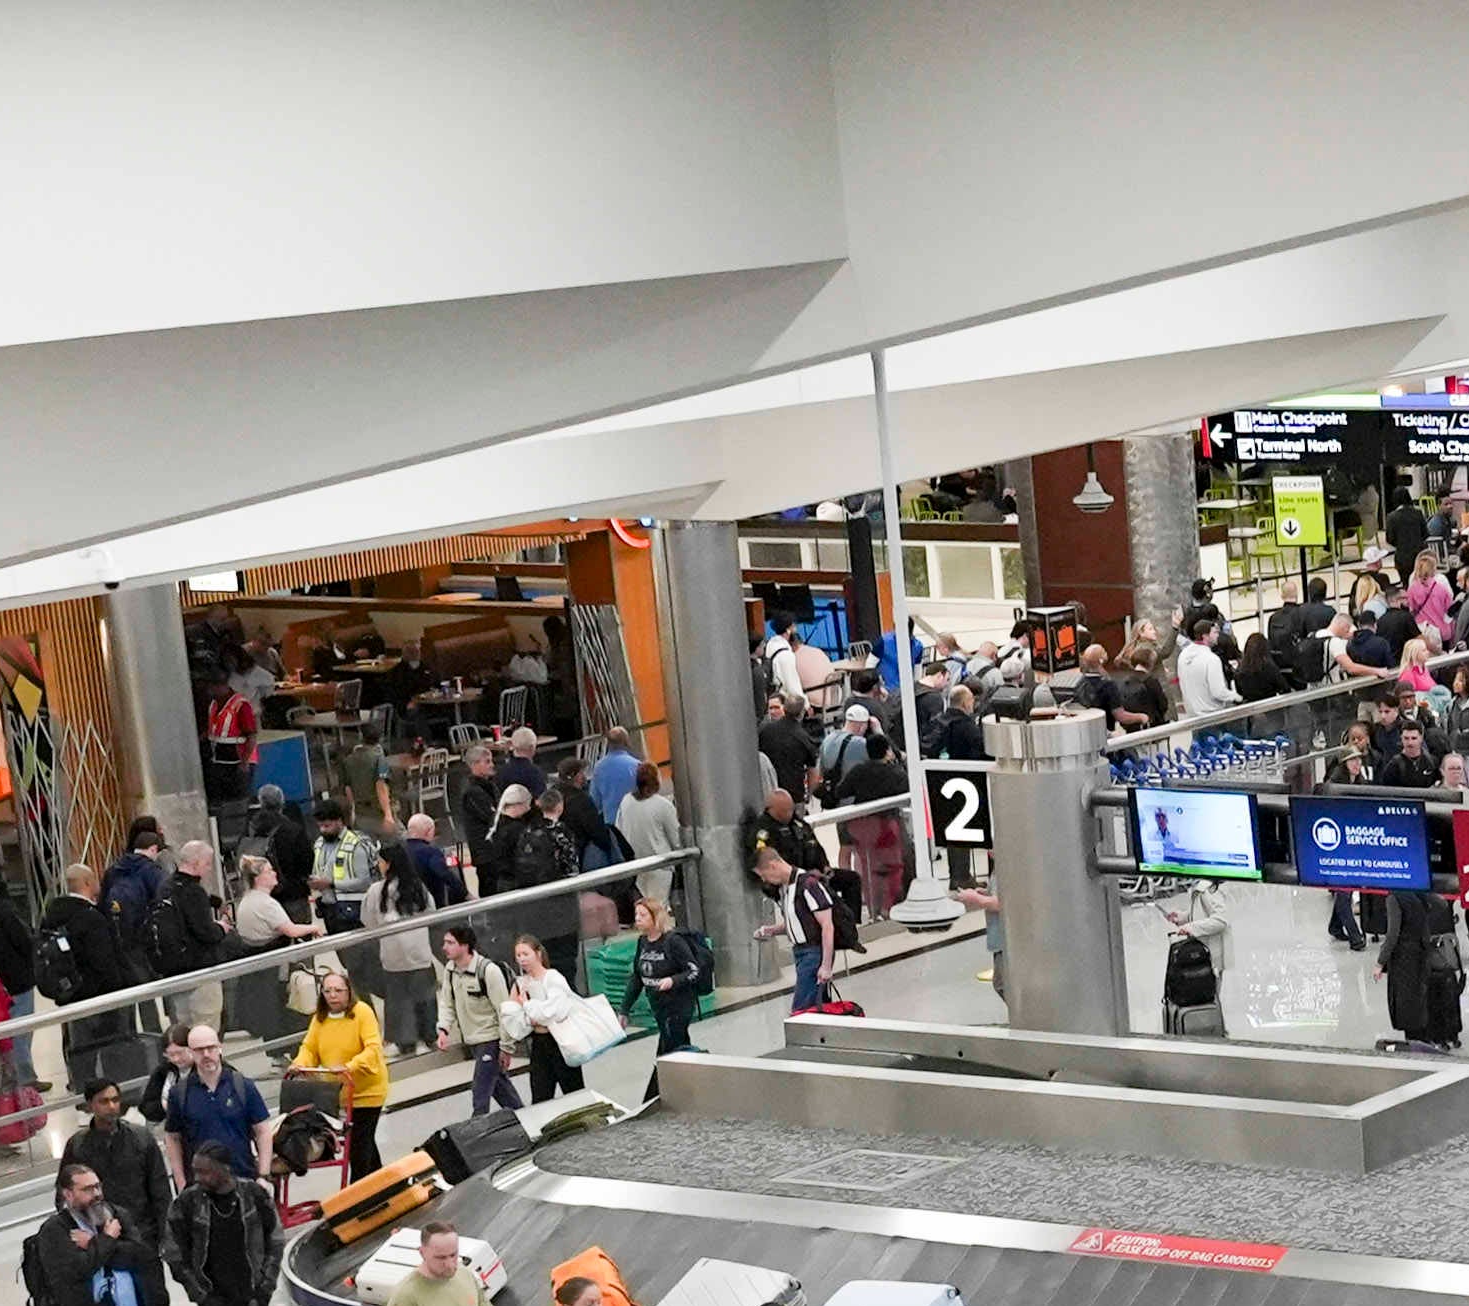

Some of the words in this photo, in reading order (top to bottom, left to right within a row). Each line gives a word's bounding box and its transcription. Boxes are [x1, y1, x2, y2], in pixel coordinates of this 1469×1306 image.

[1252, 412, 1279, 425] Main
[1281, 412, 1347, 427] Checkpoint
[1393, 413, 1448, 428] Ticketing
[1449, 413, 1458, 429] /
[1256, 439, 1306, 452] Terminal
[1307, 439, 1342, 453] North
[1408, 440, 1444, 454] South
[940, 778, 985, 843] 2
[1385, 806, 1411, 815] DELTA
[1345, 825, 1385, 837] BAGGAGE
[1345, 835, 1380, 846] SERVICE
[1381, 837, 1408, 847] OFFICE
[1103, 1243, 1143, 1256] PLEASE
[1143, 1246, 1170, 1258] KEEP
[1170, 1248, 1192, 1260] OFF
[1192, 1251, 1213, 1263] BAG
[1213, 1253, 1275, 1269] CAROUSELS
